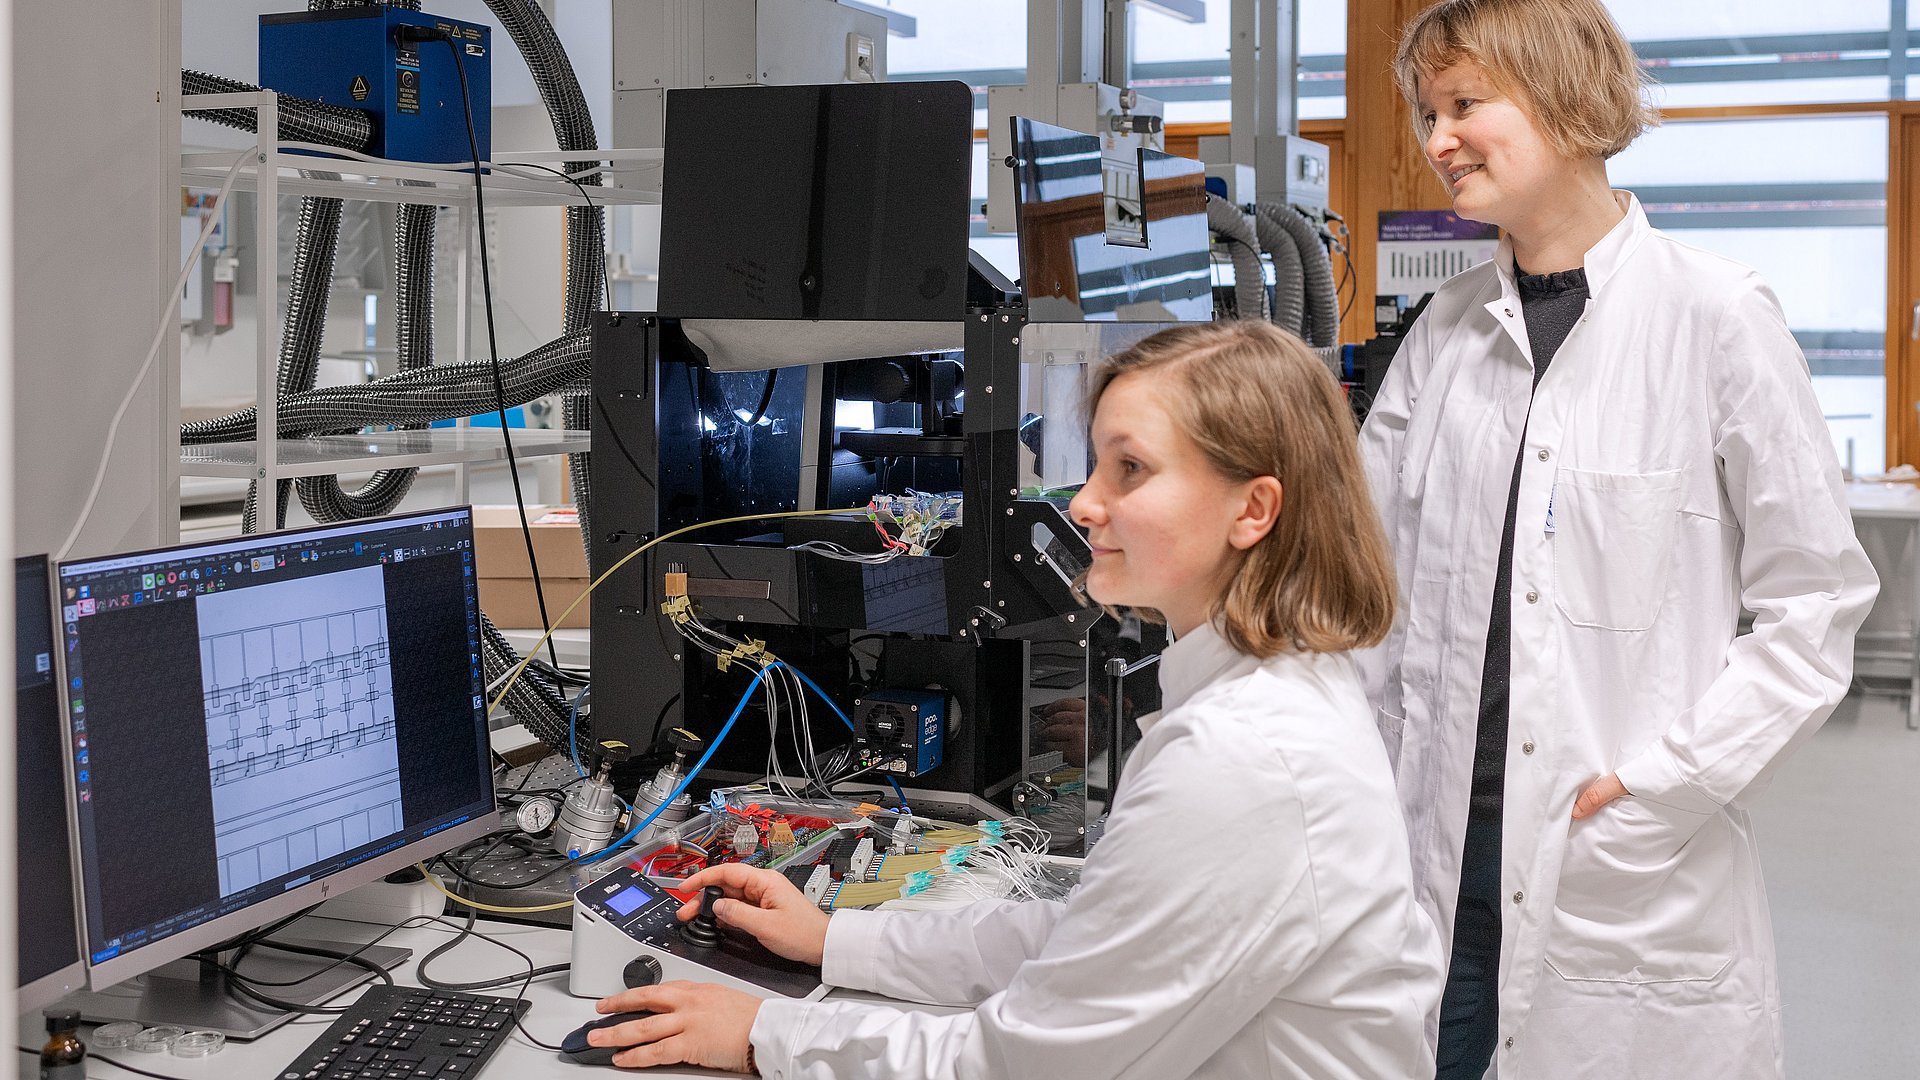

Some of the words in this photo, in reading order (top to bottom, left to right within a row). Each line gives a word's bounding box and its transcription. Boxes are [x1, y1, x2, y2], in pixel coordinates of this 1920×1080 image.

[924, 714, 938, 727] pco.
[924, 723, 938, 736] edge
[321, 881, 330, 898] hp
